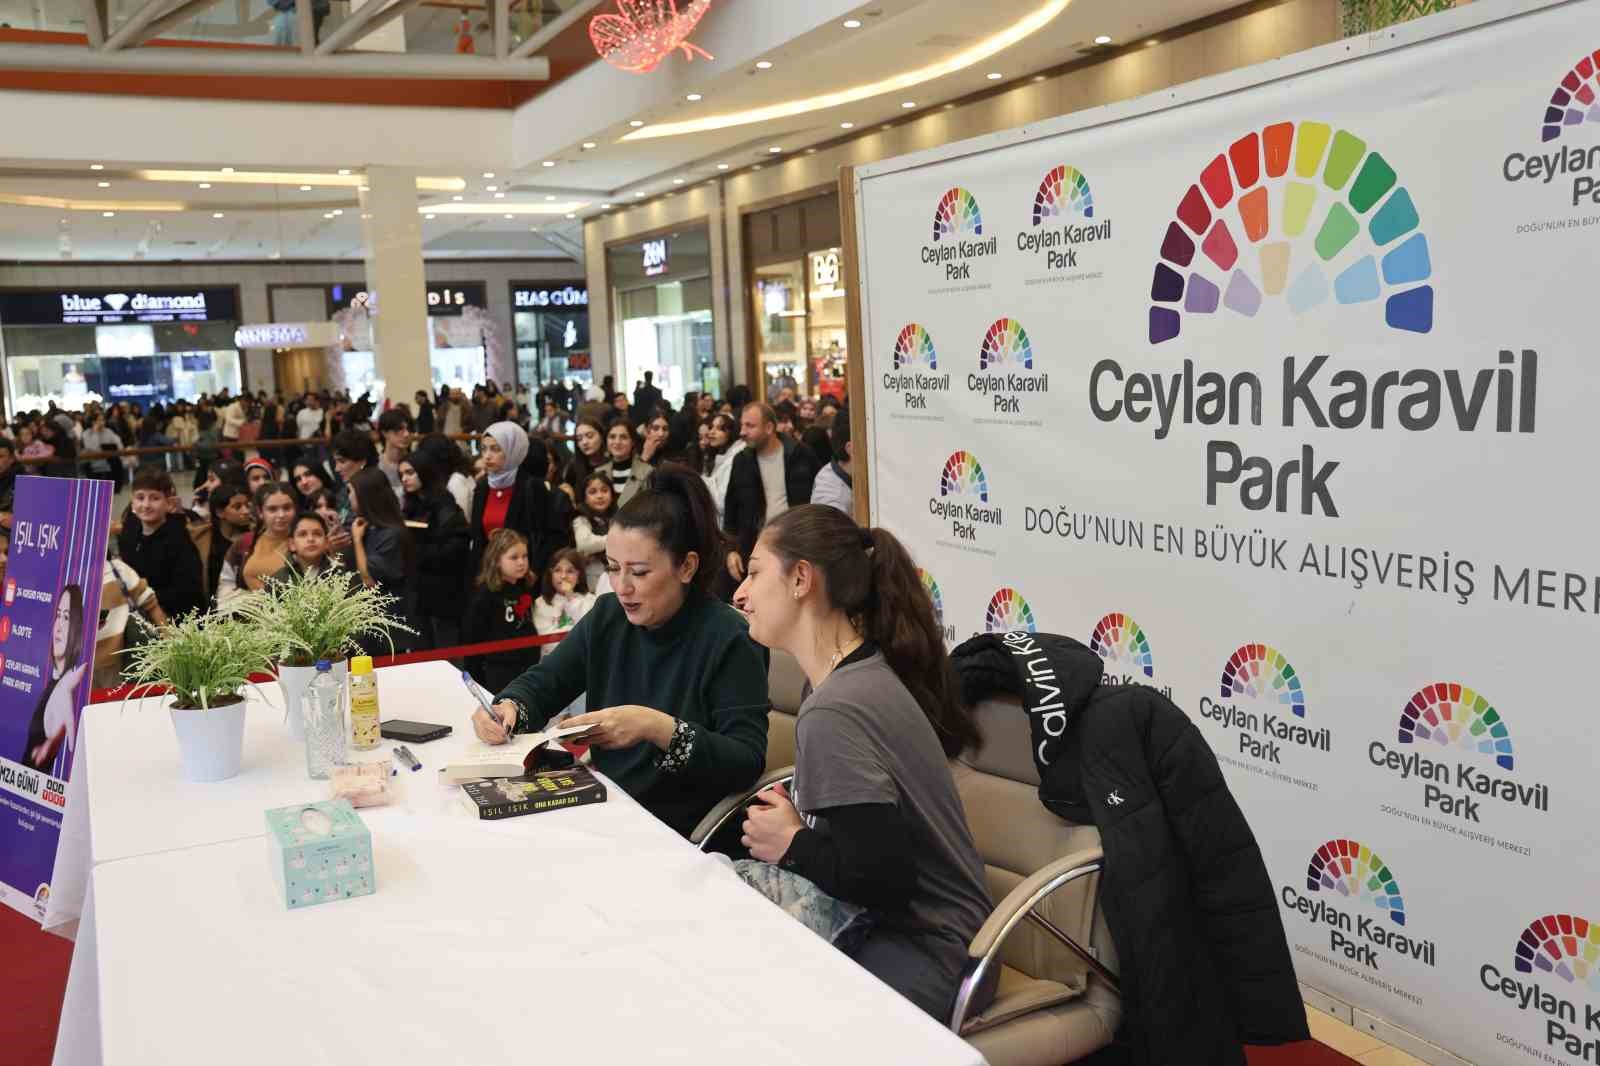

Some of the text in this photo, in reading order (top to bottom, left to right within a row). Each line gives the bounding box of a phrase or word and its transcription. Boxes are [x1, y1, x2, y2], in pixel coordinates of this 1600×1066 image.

[1572, 176, 1600, 206] Pa
[921, 236, 997, 266] Ceylan Karavil
[1017, 219, 1112, 254] Ceylan Karavil
[946, 261, 970, 280] Park
[1047, 248, 1077, 270] Park
[60, 292, 206, 311] blue diamond
[514, 290, 549, 306] HAS
[883, 372, 950, 392] Ceylan Karavil
[967, 372, 1048, 395] Ceylan Karavil
[1088, 349, 1538, 440] Ceylan Karavil
[905, 392, 927, 409] Park
[994, 394, 1020, 413] Park
[1205, 440, 1341, 519] Park
[929, 497, 1002, 526] Ceylan Karavil
[14, 520, 61, 558] IŞIL IŞIK
[953, 521, 976, 540] Park
[1024, 505, 1144, 549] DOĞU'NUN
[1152, 523, 1184, 555] EN
[1194, 524, 1288, 571] BÜYÜK
[1299, 542, 1475, 605] ALIŞVERİŞ
[1002, 630, 1043, 655] Kle
[1199, 696, 1331, 752] Ceylan Karavil
[1239, 732, 1281, 764] Park
[0, 765, 15, 787] MZA
[17, 770, 39, 795] GÜNÜ
[1368, 740, 1549, 812] Ceylan Karavil
[1424, 783, 1480, 823] Park
[1281, 885, 1435, 967] Ceylan Karavil
[1330, 930, 1379, 970] Park
[1480, 963, 1576, 1024] Ceylan
[1546, 1019, 1600, 1066] Par
